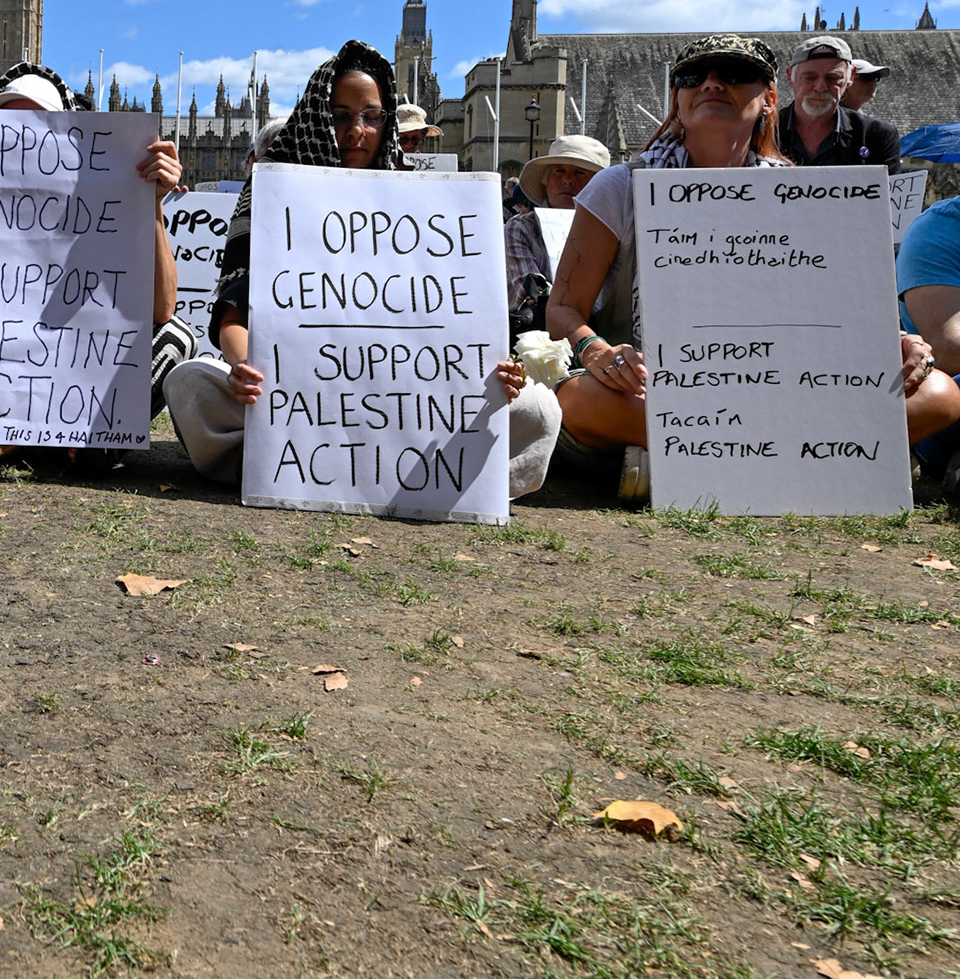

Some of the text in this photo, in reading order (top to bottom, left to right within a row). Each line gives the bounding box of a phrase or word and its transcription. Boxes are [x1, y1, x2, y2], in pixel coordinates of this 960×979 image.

[649, 182, 656, 206] I
[669, 183, 756, 203] OPPOSE
[774, 183, 881, 204] GENOCIDE
[285, 206, 482, 257] I OPPOSE
[709, 228, 716, 243] i
[272, 270, 473, 315] GENOCIDE
[273, 343, 491, 385] I SUPPORT
[658, 342, 775, 368] I SUPPORT
[652, 369, 885, 389] PALESTINE ACTION
[270, 389, 486, 434] PALESTINE
[3, 426, 32, 442] THIS
[37, 430, 51, 444] IS
[55, 432, 66, 444] 4
[665, 436, 880, 460] PALESTINE ACTION
[273, 439, 465, 493] ACTION
